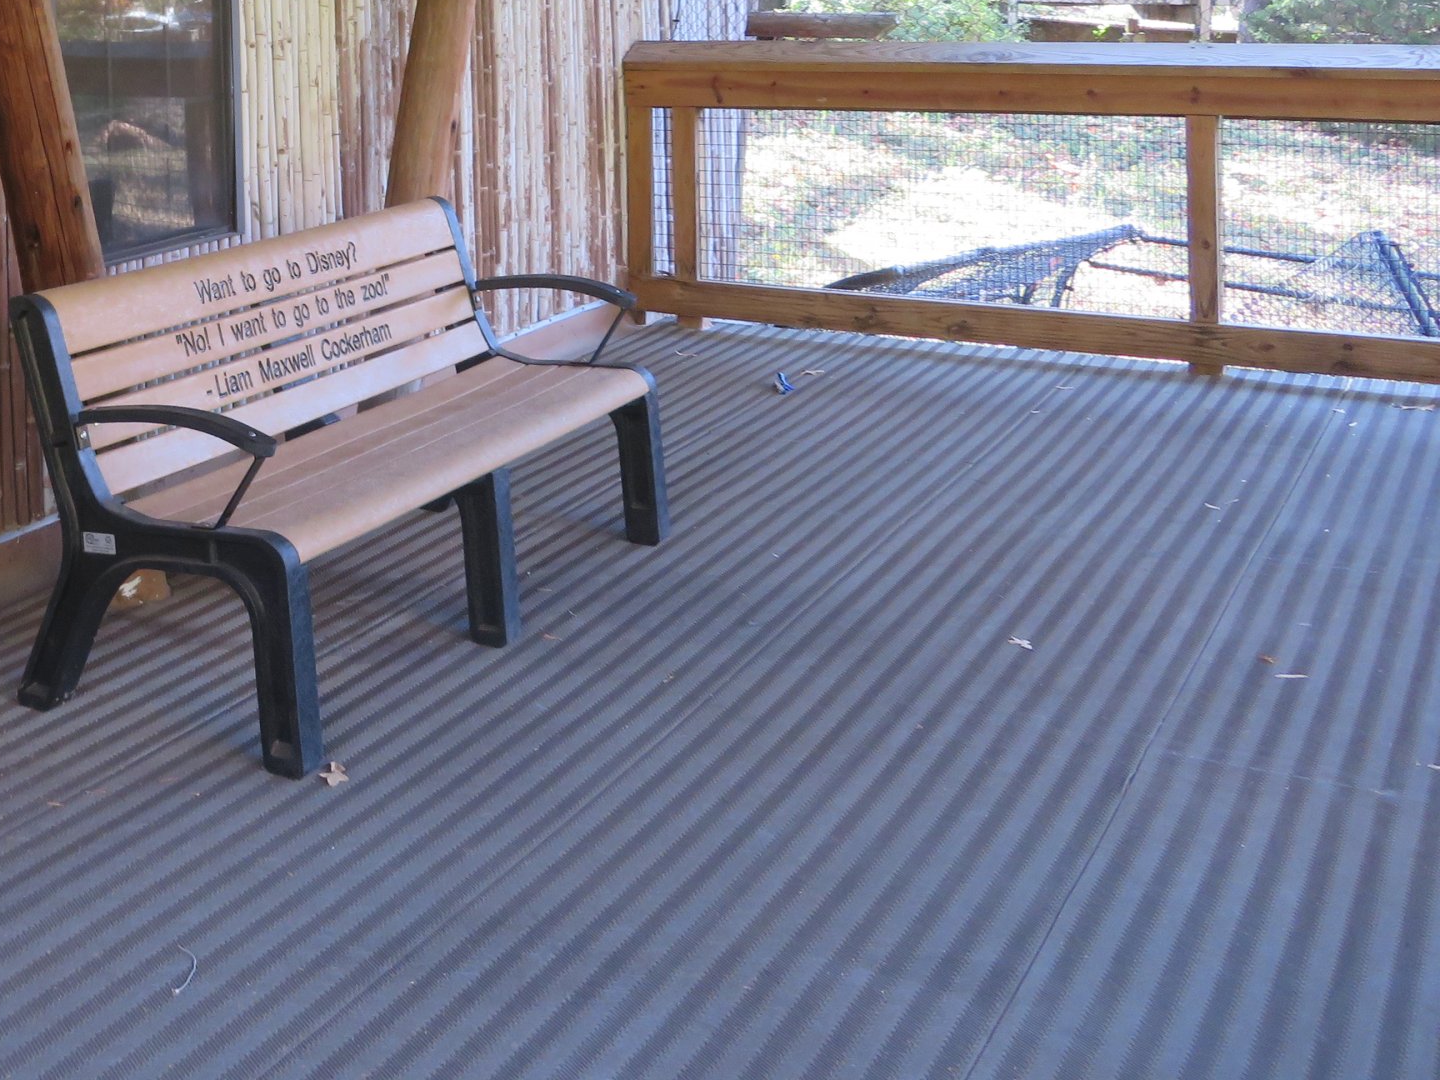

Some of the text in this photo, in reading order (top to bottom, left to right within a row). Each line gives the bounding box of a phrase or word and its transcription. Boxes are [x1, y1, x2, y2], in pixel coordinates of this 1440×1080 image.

[193, 242, 357, 304] Want to go to Disney?
[175, 326, 212, 357] "No!
[217, 322, 225, 347] I
[231, 315, 267, 341] want
[271, 307, 287, 327] to
[293, 303, 310, 327] go
[315, 295, 330, 315] to
[334, 285, 356, 309] the
[214, 370, 254, 398] Liam
[258, 344, 315, 383] Maxwell
[321, 323, 392, 360] Cockerham
